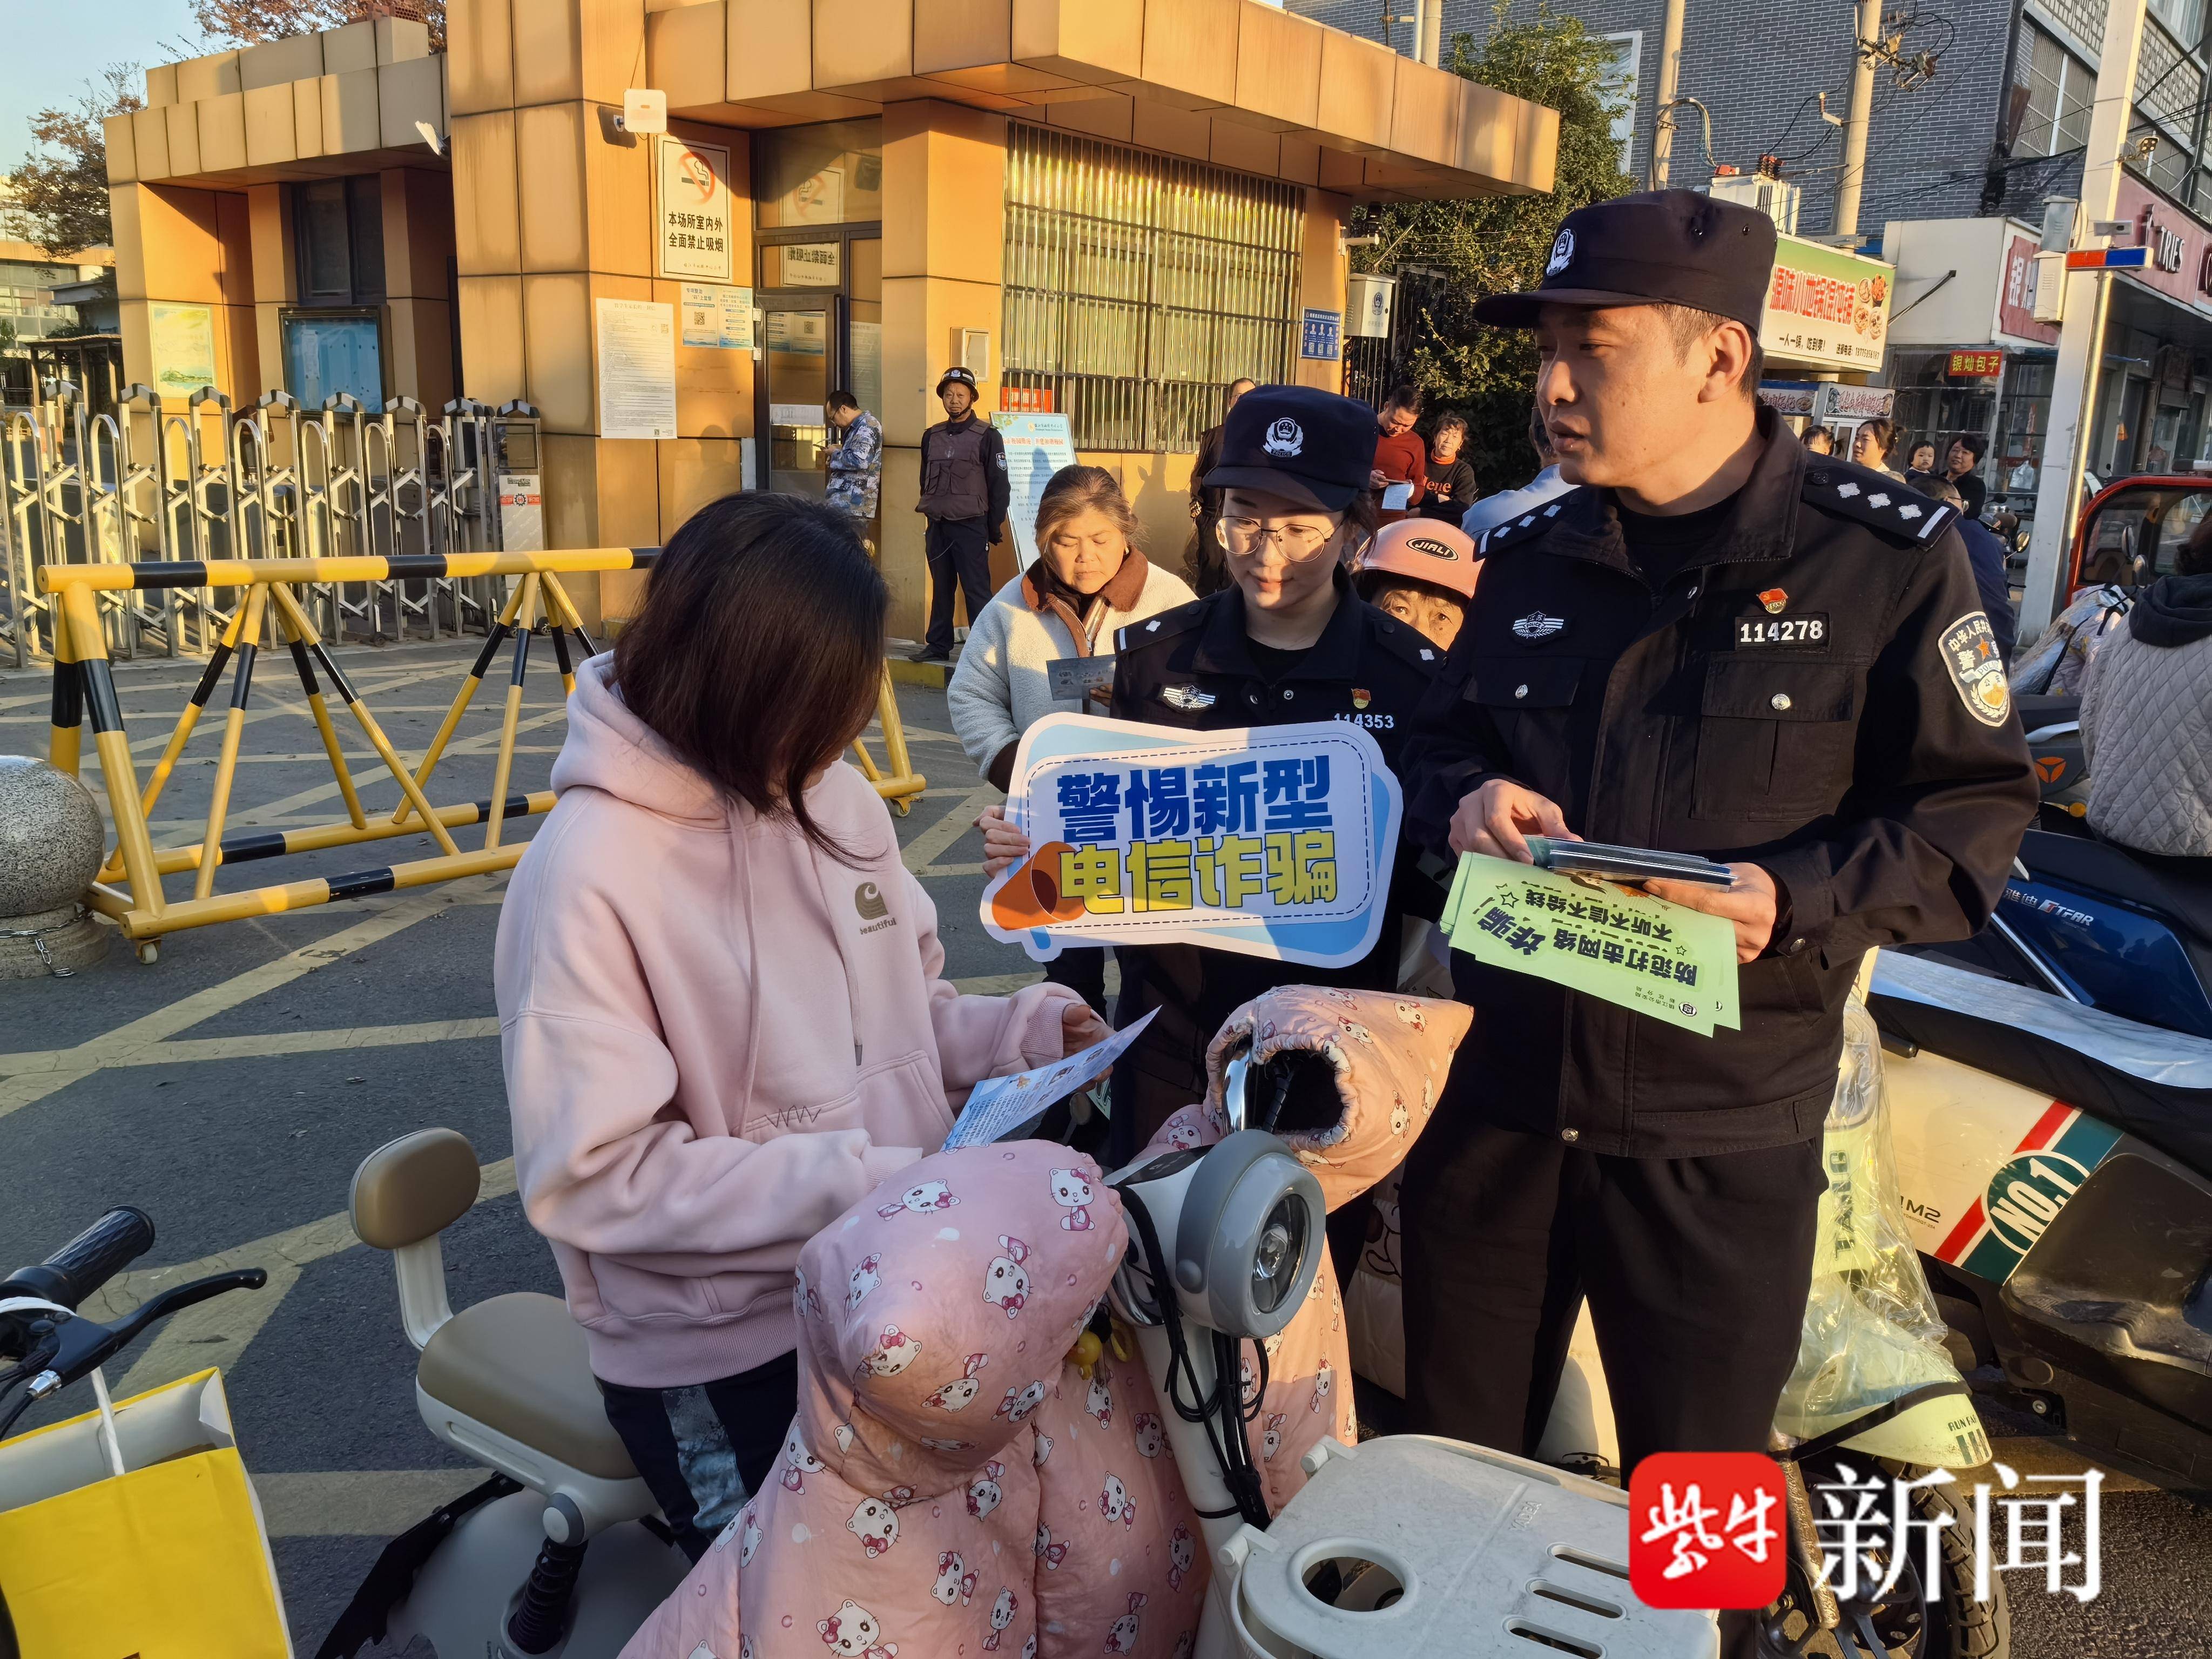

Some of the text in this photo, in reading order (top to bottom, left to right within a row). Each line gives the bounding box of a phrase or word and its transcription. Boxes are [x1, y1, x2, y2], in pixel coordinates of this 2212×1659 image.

[669, 211, 723, 232] 本场所室内外
[669, 232, 723, 252] 全面禁止吸烟
[1952, 355, 1999, 372] 银灿包子
[1415, 542, 1450, 556] JIALI
[1739, 619, 1823, 643] 114278
[1057, 755, 1333, 844] 警惕新型
[1057, 829, 1337, 914] 电信诈骗
[1525, 889, 1673, 943] 不听不信不给钱
[1476, 906, 1697, 987] 防范打击网络 诈骗
[1634, 992, 1676, 1010] 镇江市公安局
[1900, 1196, 1941, 1223] M2
[1990, 1157, 2081, 1242] NO.1
[1947, 1418, 1967, 1432] RUN
